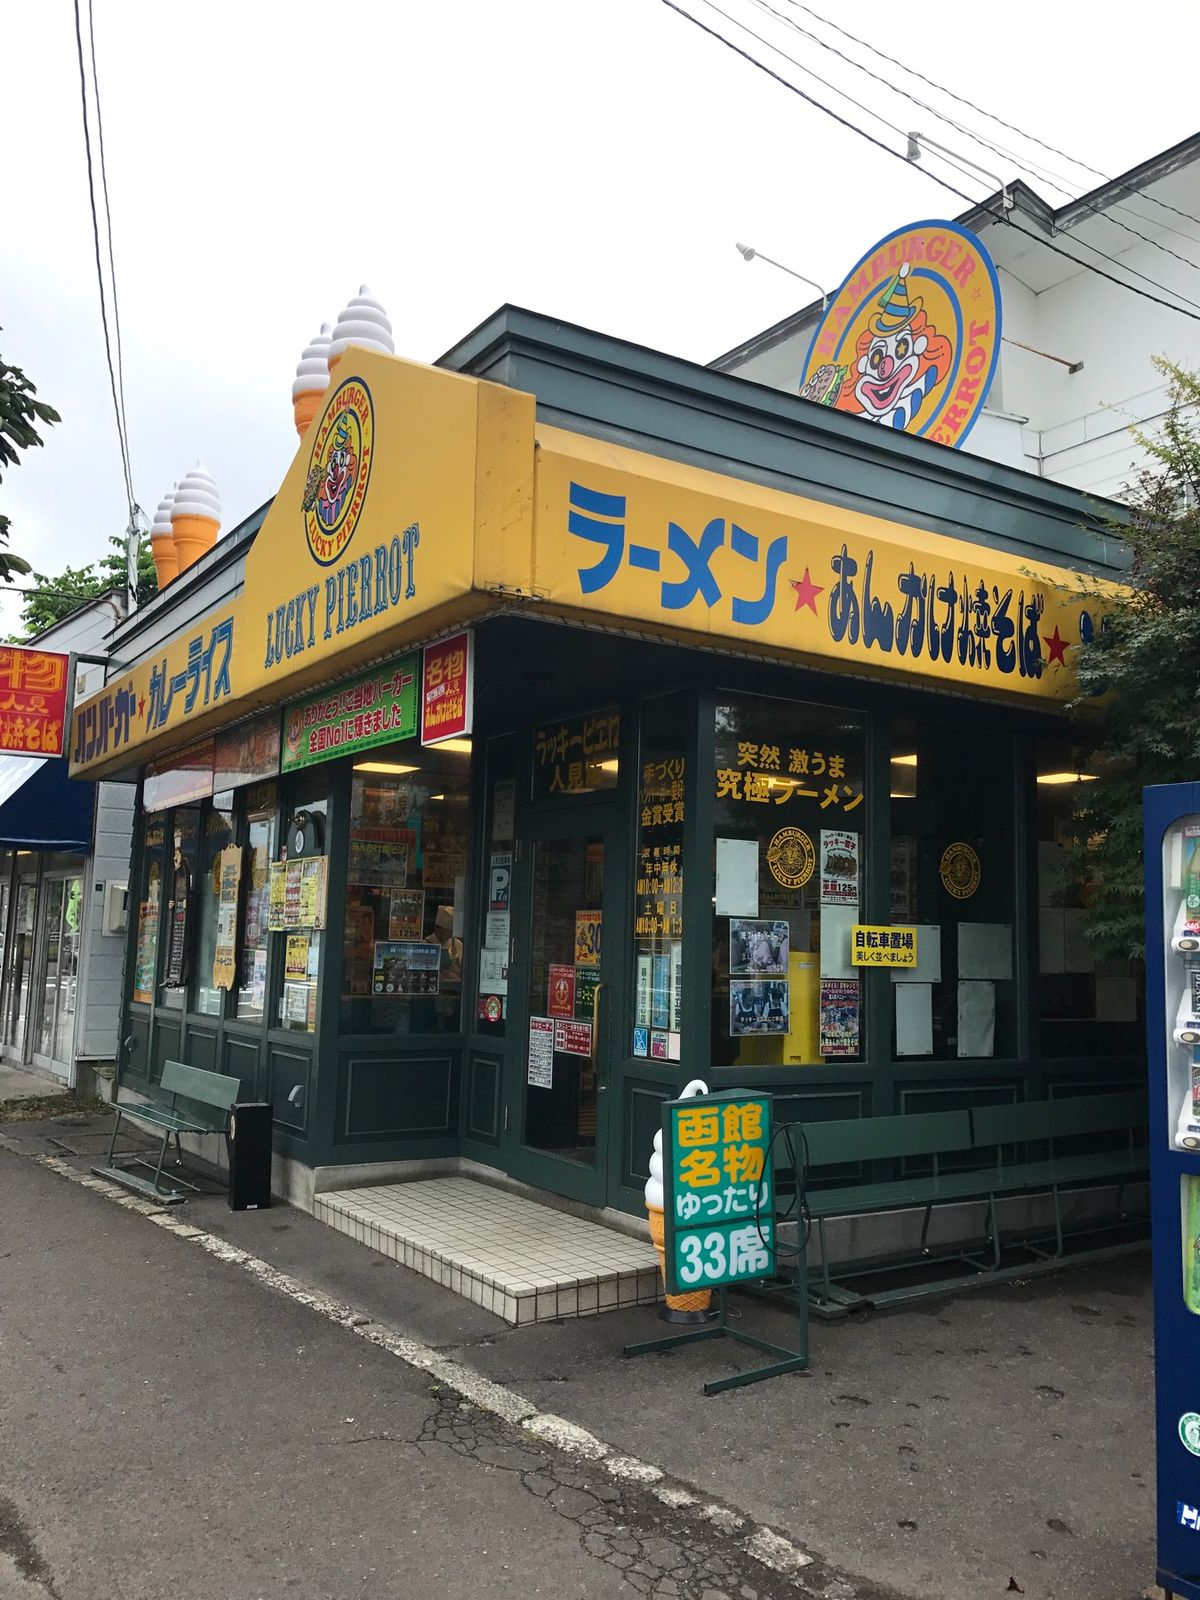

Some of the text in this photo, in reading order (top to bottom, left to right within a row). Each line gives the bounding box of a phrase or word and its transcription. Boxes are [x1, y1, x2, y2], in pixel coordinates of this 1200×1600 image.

[817, 235, 976, 356] HAMBURGER
[314, 385, 369, 459] HAMBURGER
[308, 446, 371, 558] LUCKY PIERROT
[568, 480, 788, 625] ラーメン
[264, 522, 420, 669] LUCKY PIERROT
[145, 615, 235, 734] カレーライス
[427, 649, 465, 688] 名物
[74, 680, 136, 766] ハンバーガー
[536, 714, 620, 767] ラッキーピエロ
[643, 757, 685, 784] 手づくり
[737, 741, 846, 779] 突然 激うま
[716, 767, 865, 813] 究極ラーメン
[640, 800, 685, 827] 金賞受賞
[773, 830, 812, 851] HAMBURGER
[772, 857, 813, 885] LUCKY PIERROT
[855, 930, 914, 950] 自転車置場
[855, 951, 914, 964] 美しく並べましょう
[679, 1143, 765, 1188] 名物
[676, 1182, 769, 1220] ゆったり
[680, 1225, 770, 1283] 33席
